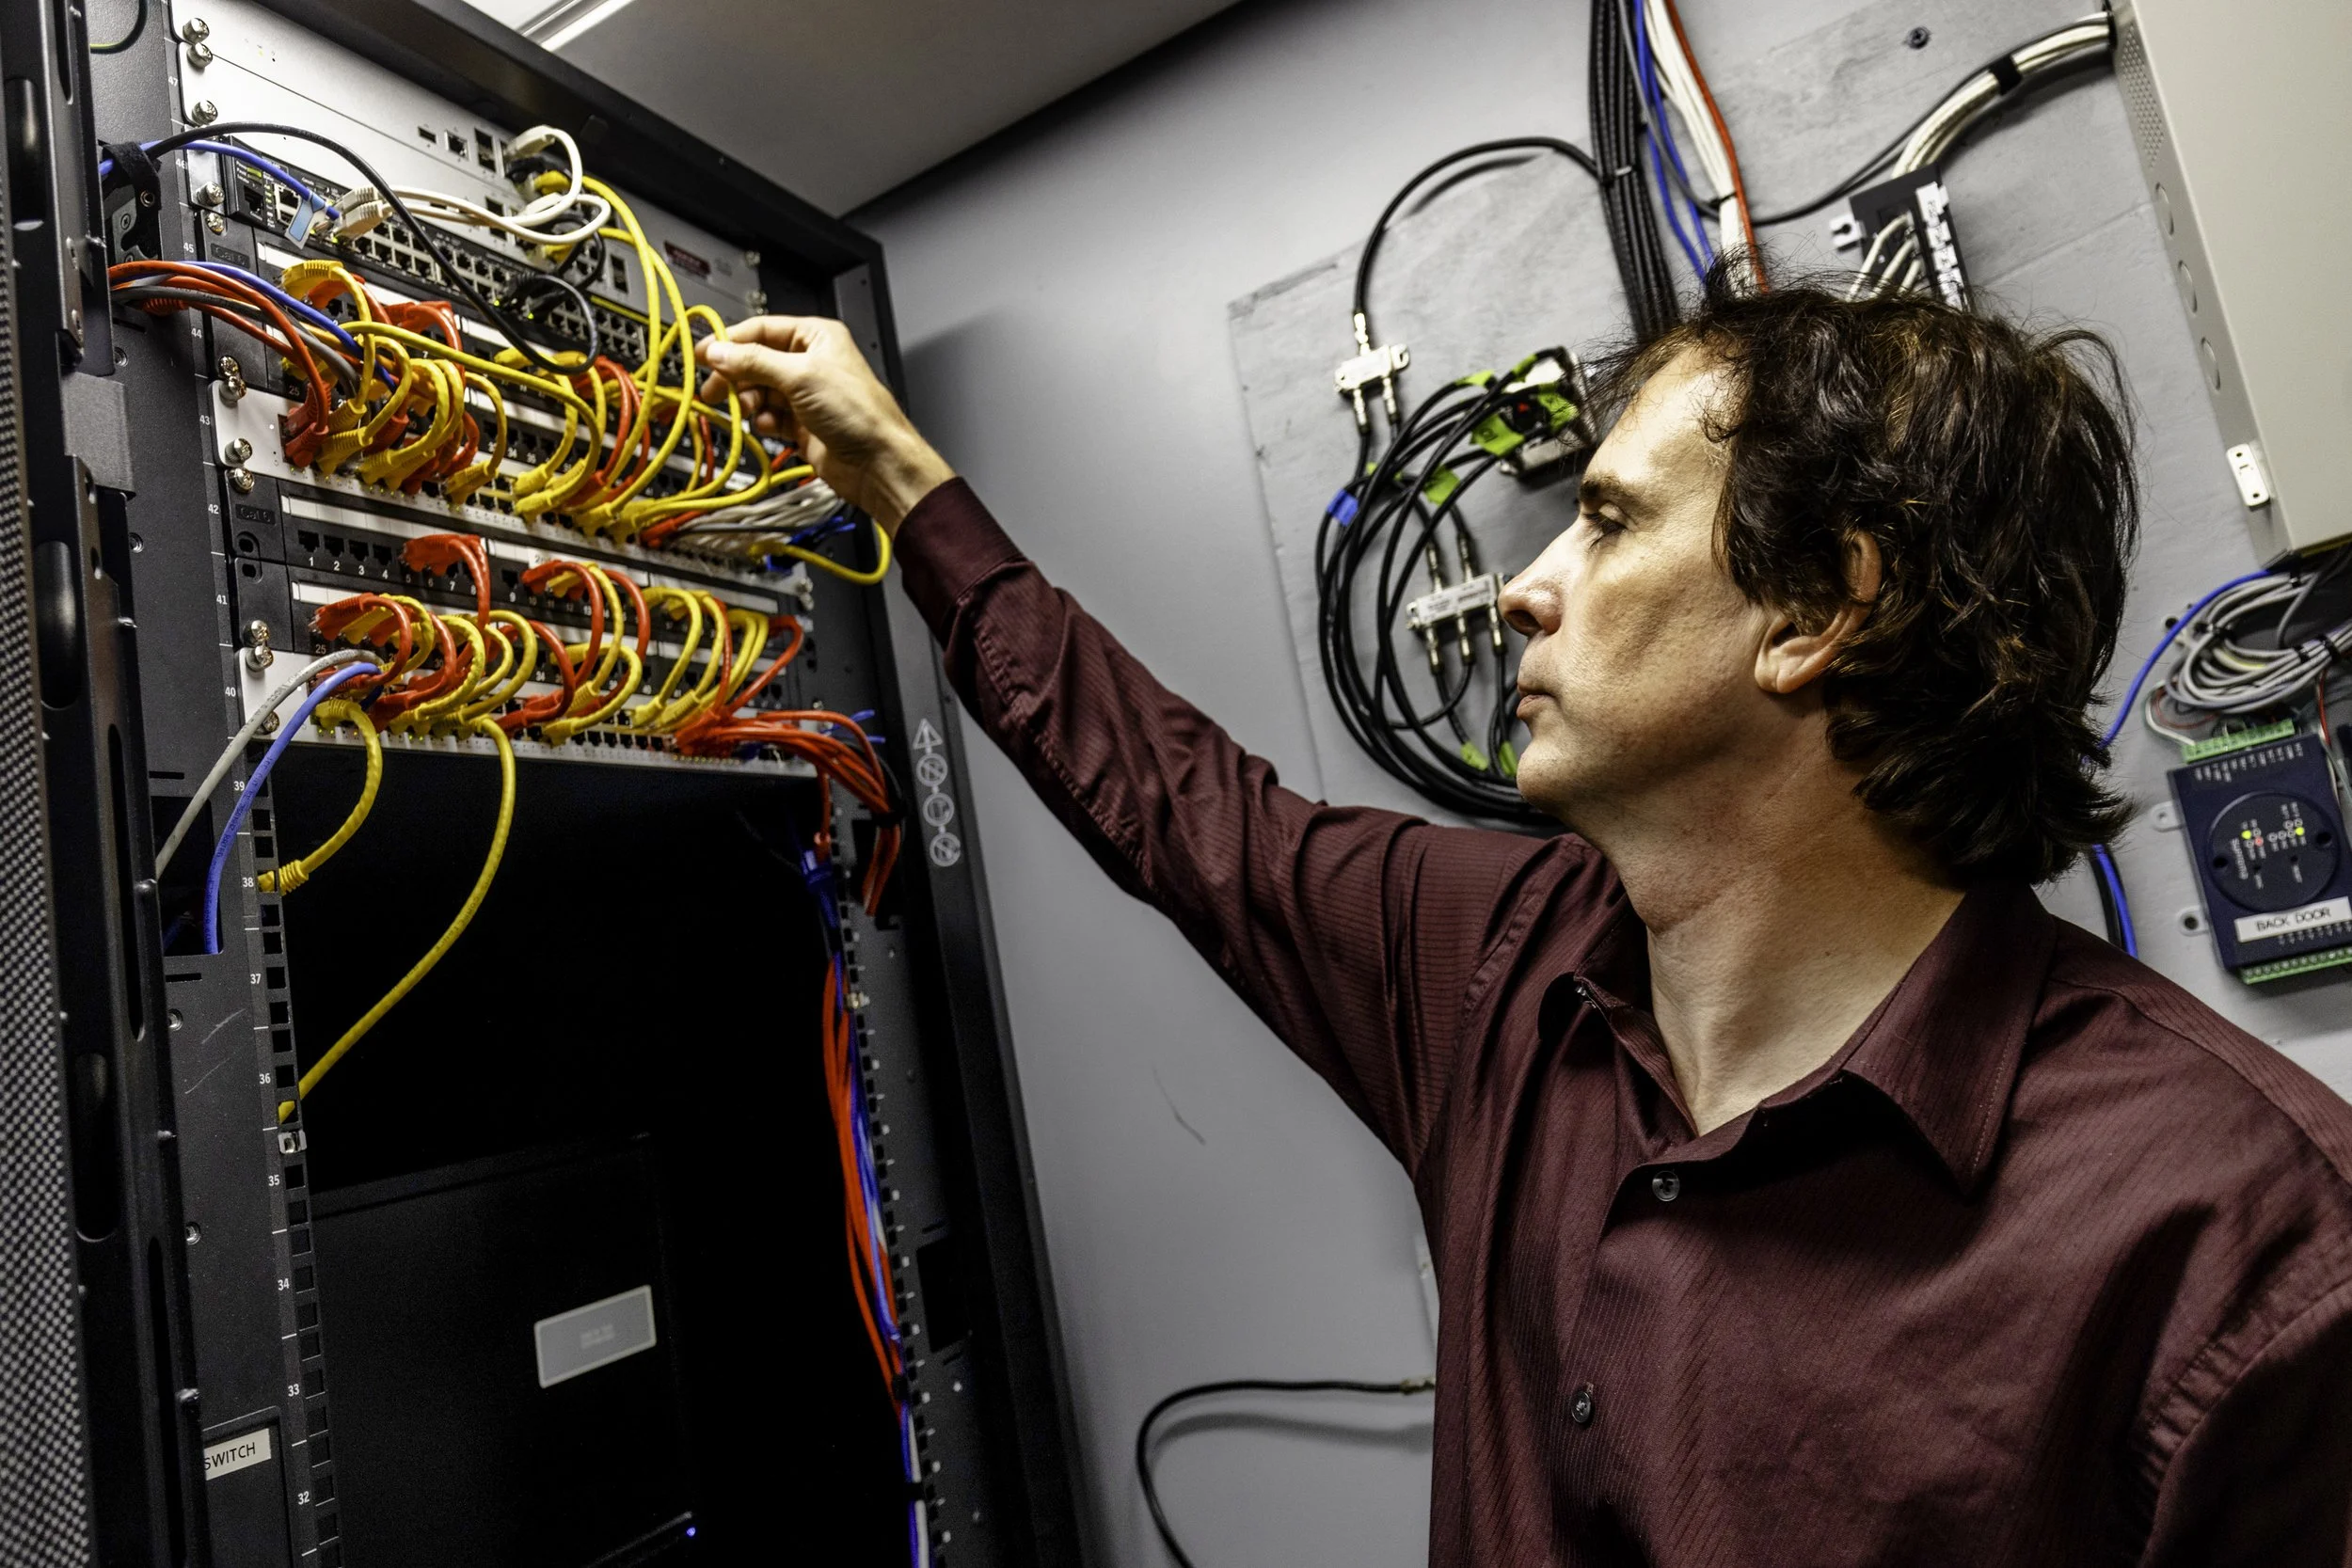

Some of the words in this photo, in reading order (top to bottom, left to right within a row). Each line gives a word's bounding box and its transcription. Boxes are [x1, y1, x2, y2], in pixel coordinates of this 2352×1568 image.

[167, 75, 179, 87] 47
[175, 158, 188, 170] 46
[183, 241, 195, 254] 45
[190, 326, 202, 340] 44
[422, 350, 429, 359] 7
[288, 386, 300, 397] 25
[199, 414, 211, 426] 43
[207, 503, 219, 515] 42
[309, 556, 314, 567] 1
[333, 561, 341, 572] 2
[358, 564, 365, 577] 3
[382, 568, 389, 580] 4
[405, 574, 412, 584] 5
[427, 577, 434, 588] 6
[449, 580, 456, 592] 7
[470, 585, 477, 596] 8
[509, 591, 516, 603] 9
[215, 594, 229, 606] 41
[315, 642, 327, 656] 25
[225, 686, 237, 698] 40
[232, 780, 246, 792] 39
[242, 876, 255, 888] 38
[2256, 915, 2290, 932] BACK
[2296, 906, 2331, 925] DOOR
[249, 973, 262, 985] 37
[259, 1072, 272, 1085] 36
[267, 1173, 280, 1187] 35
[277, 1277, 290, 1291] 34
[287, 1383, 300, 1398] 33
[204, 1441, 256, 1471] SWITCH
[296, 1490, 310, 1506] 32
